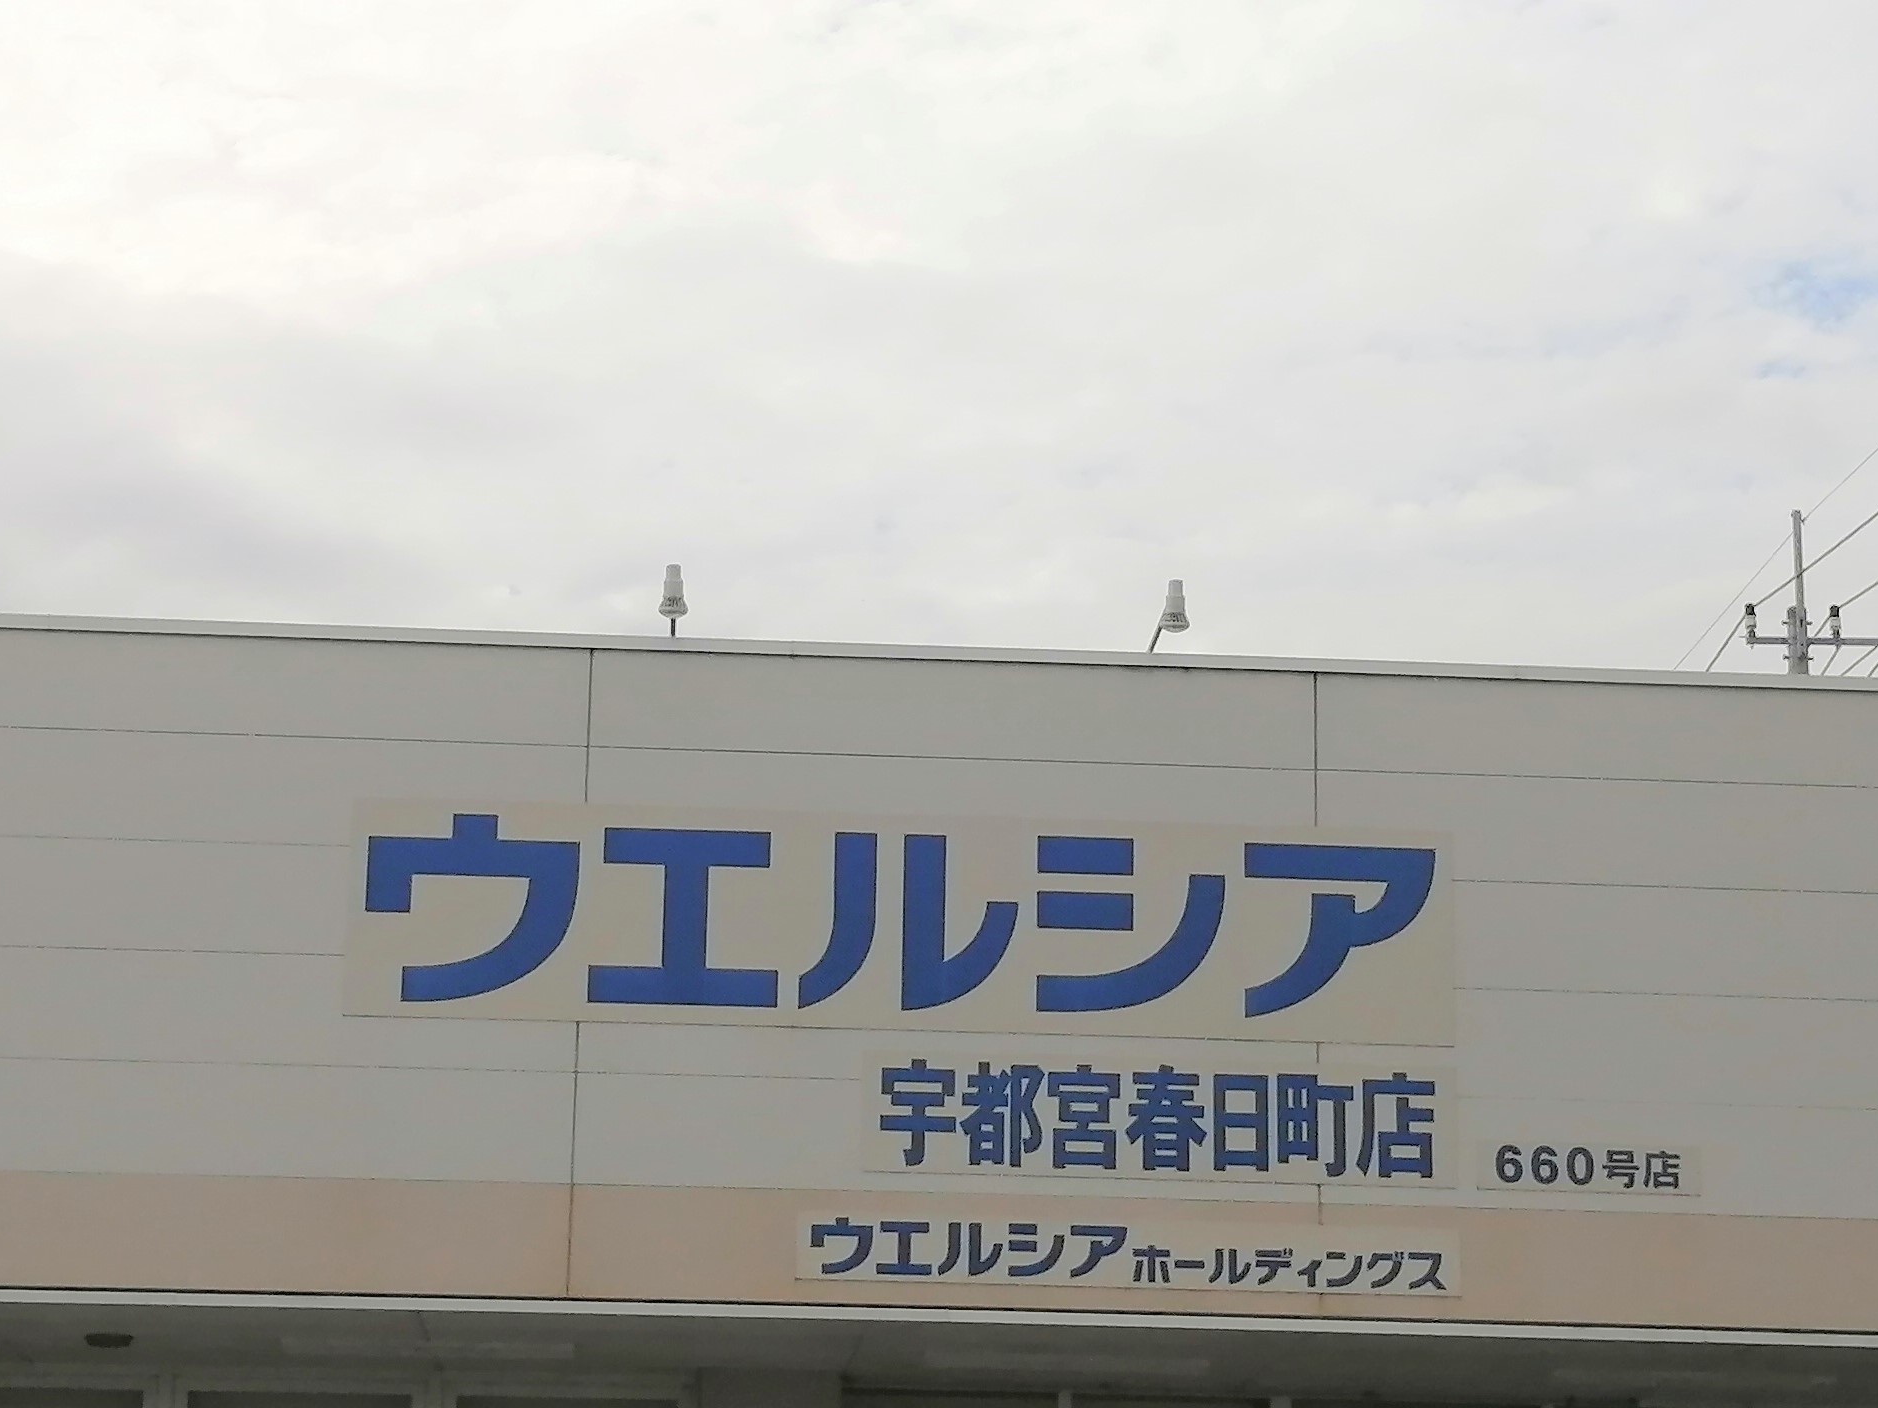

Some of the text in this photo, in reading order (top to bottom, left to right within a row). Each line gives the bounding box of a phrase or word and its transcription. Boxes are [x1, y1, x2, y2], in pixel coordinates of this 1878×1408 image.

[364, 812, 1438, 1019] ウエルシア
[879, 1058, 1437, 1180] 宇都宮春日町店
[1493, 1144, 1682, 1191] 660号店
[807, 1215, 1447, 1292] ウエルシアホールディングス
